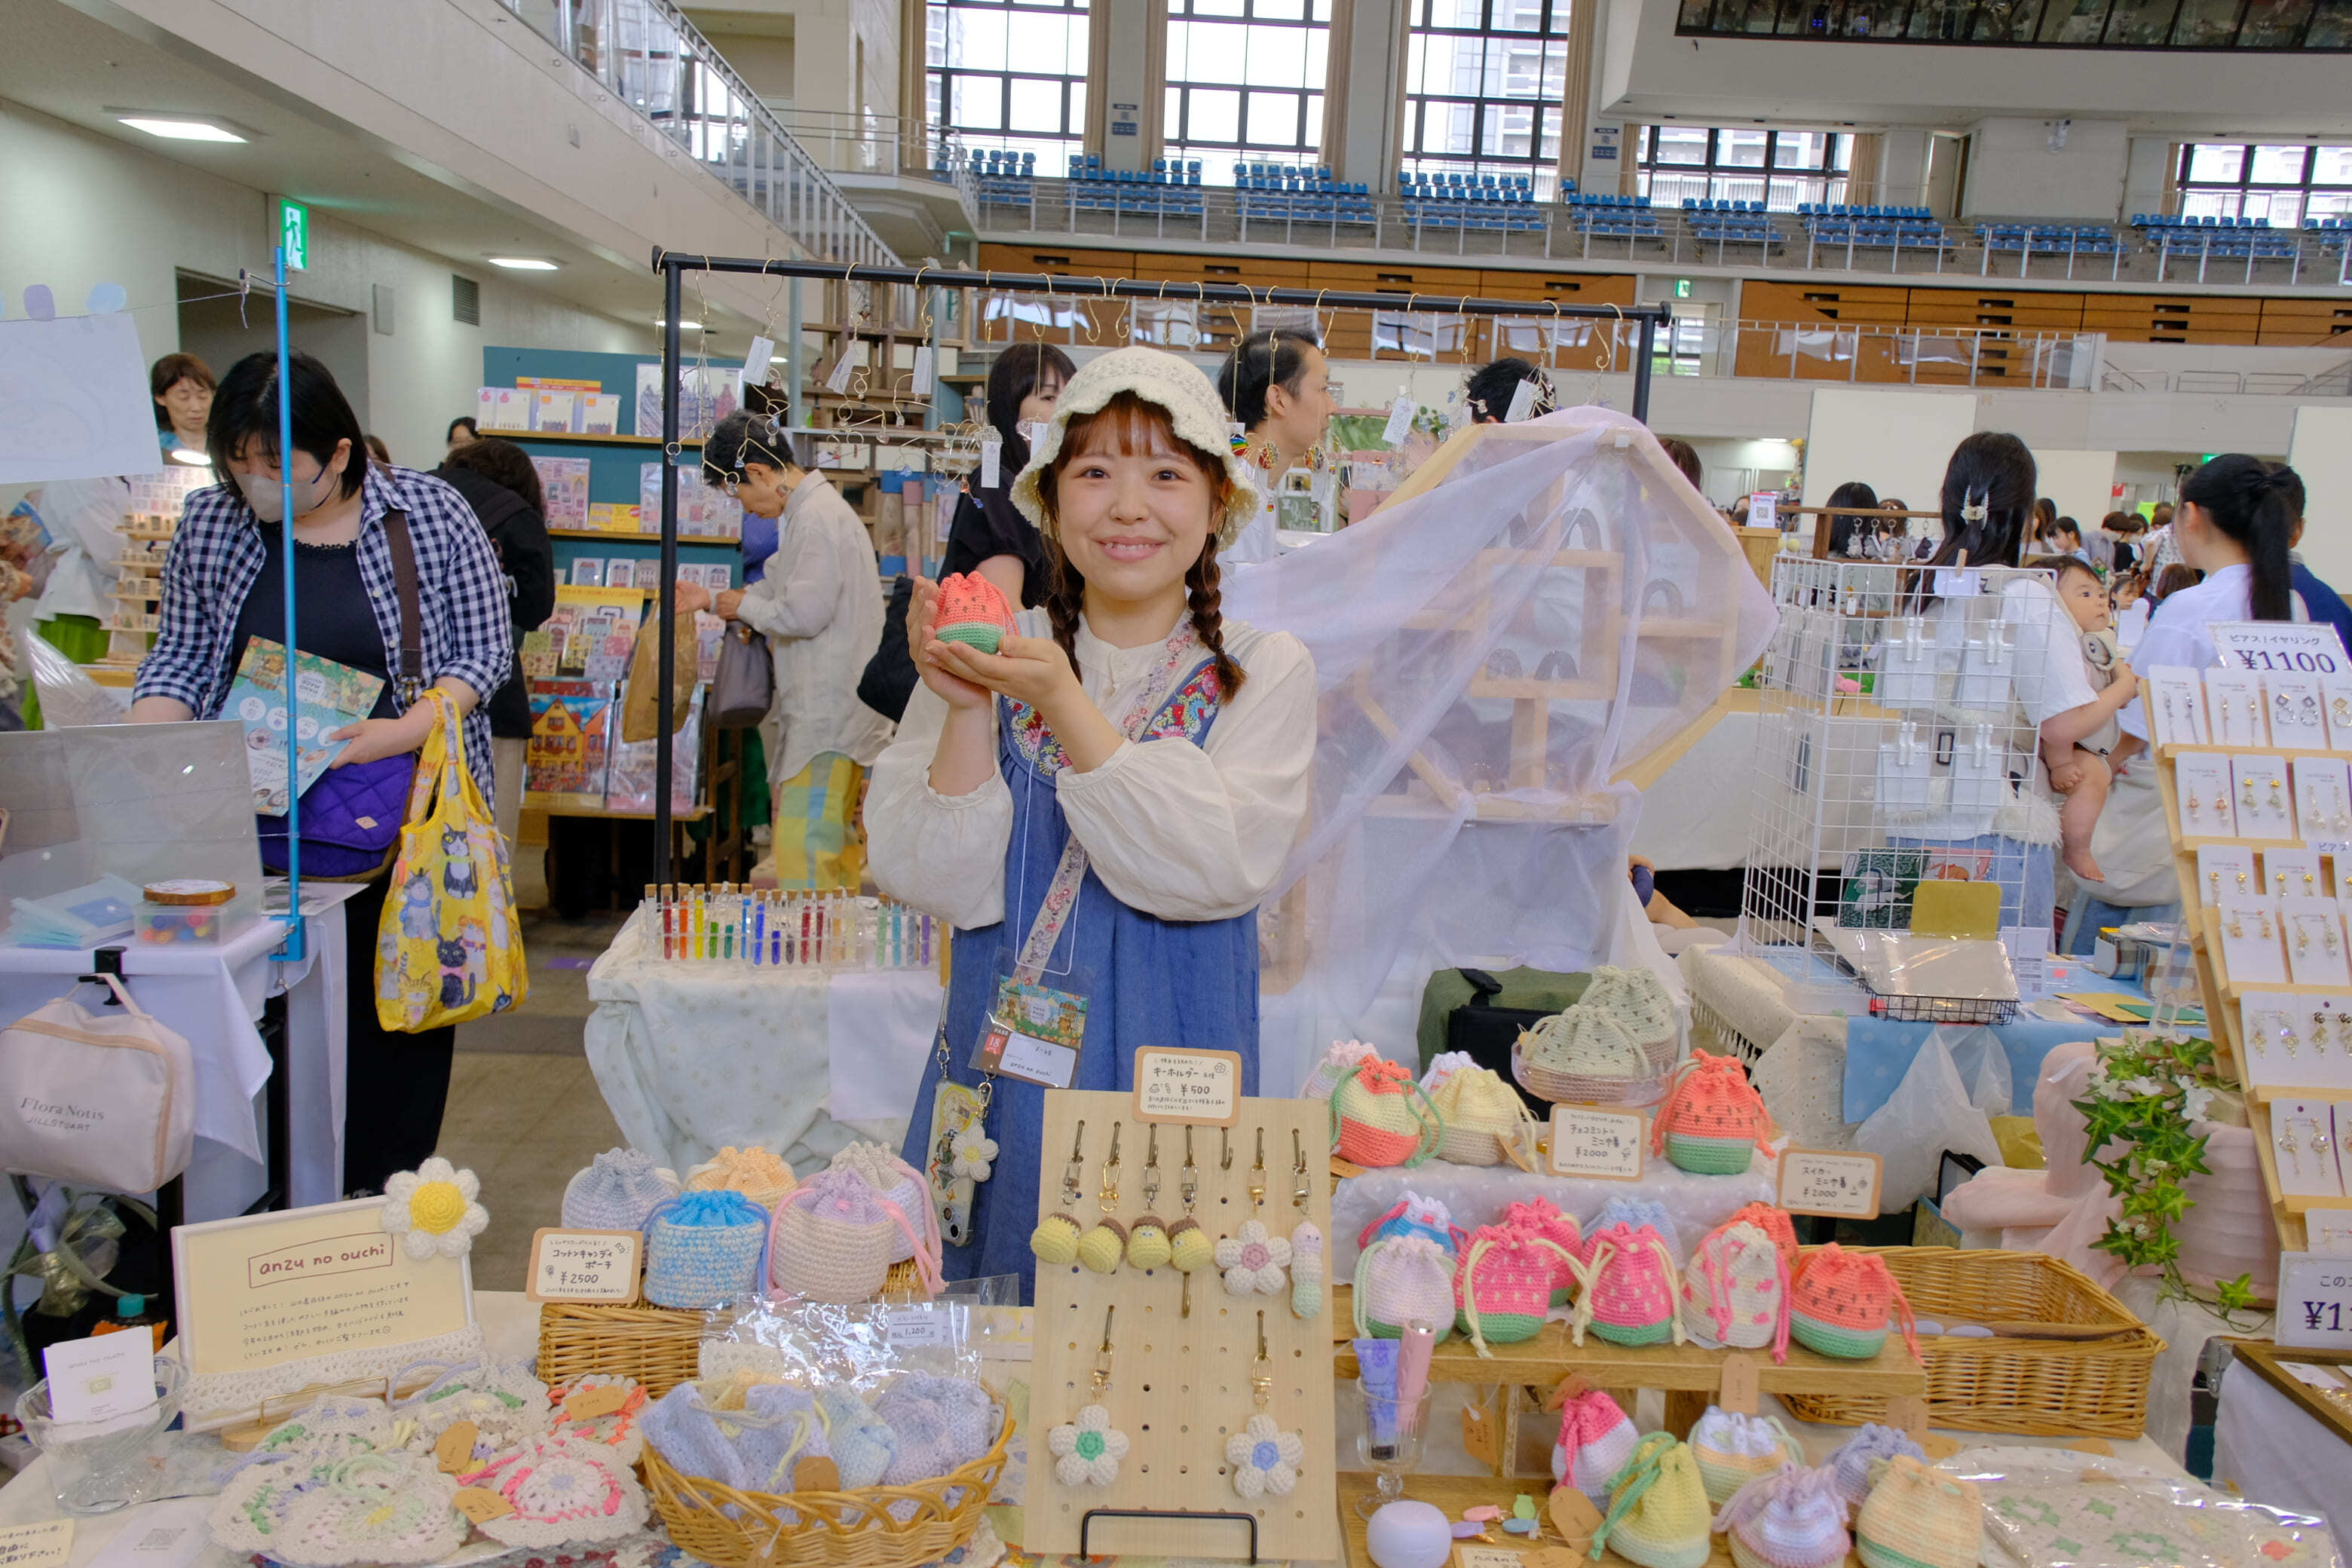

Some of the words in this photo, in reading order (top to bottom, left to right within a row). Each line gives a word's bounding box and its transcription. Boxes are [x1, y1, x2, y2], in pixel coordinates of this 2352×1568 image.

[2234, 649, 2336, 673] ¥1100
[1153, 1067, 1199, 1077] キーホルダー
[1181, 1083, 1210, 1096] ¥500
[21, 1097, 63, 1115] Flora
[66, 1104, 106, 1121] Notis
[26, 1116, 91, 1132] JILLSTUART
[259, 1258, 305, 1275] anzu
[313, 1255, 332, 1266] no
[341, 1243, 385, 1261] ouchi
[553, 1249, 612, 1259] コットンキャンディ
[585, 1260, 612, 1269] ポーチ
[560, 1271, 599, 1285] ¥2500
